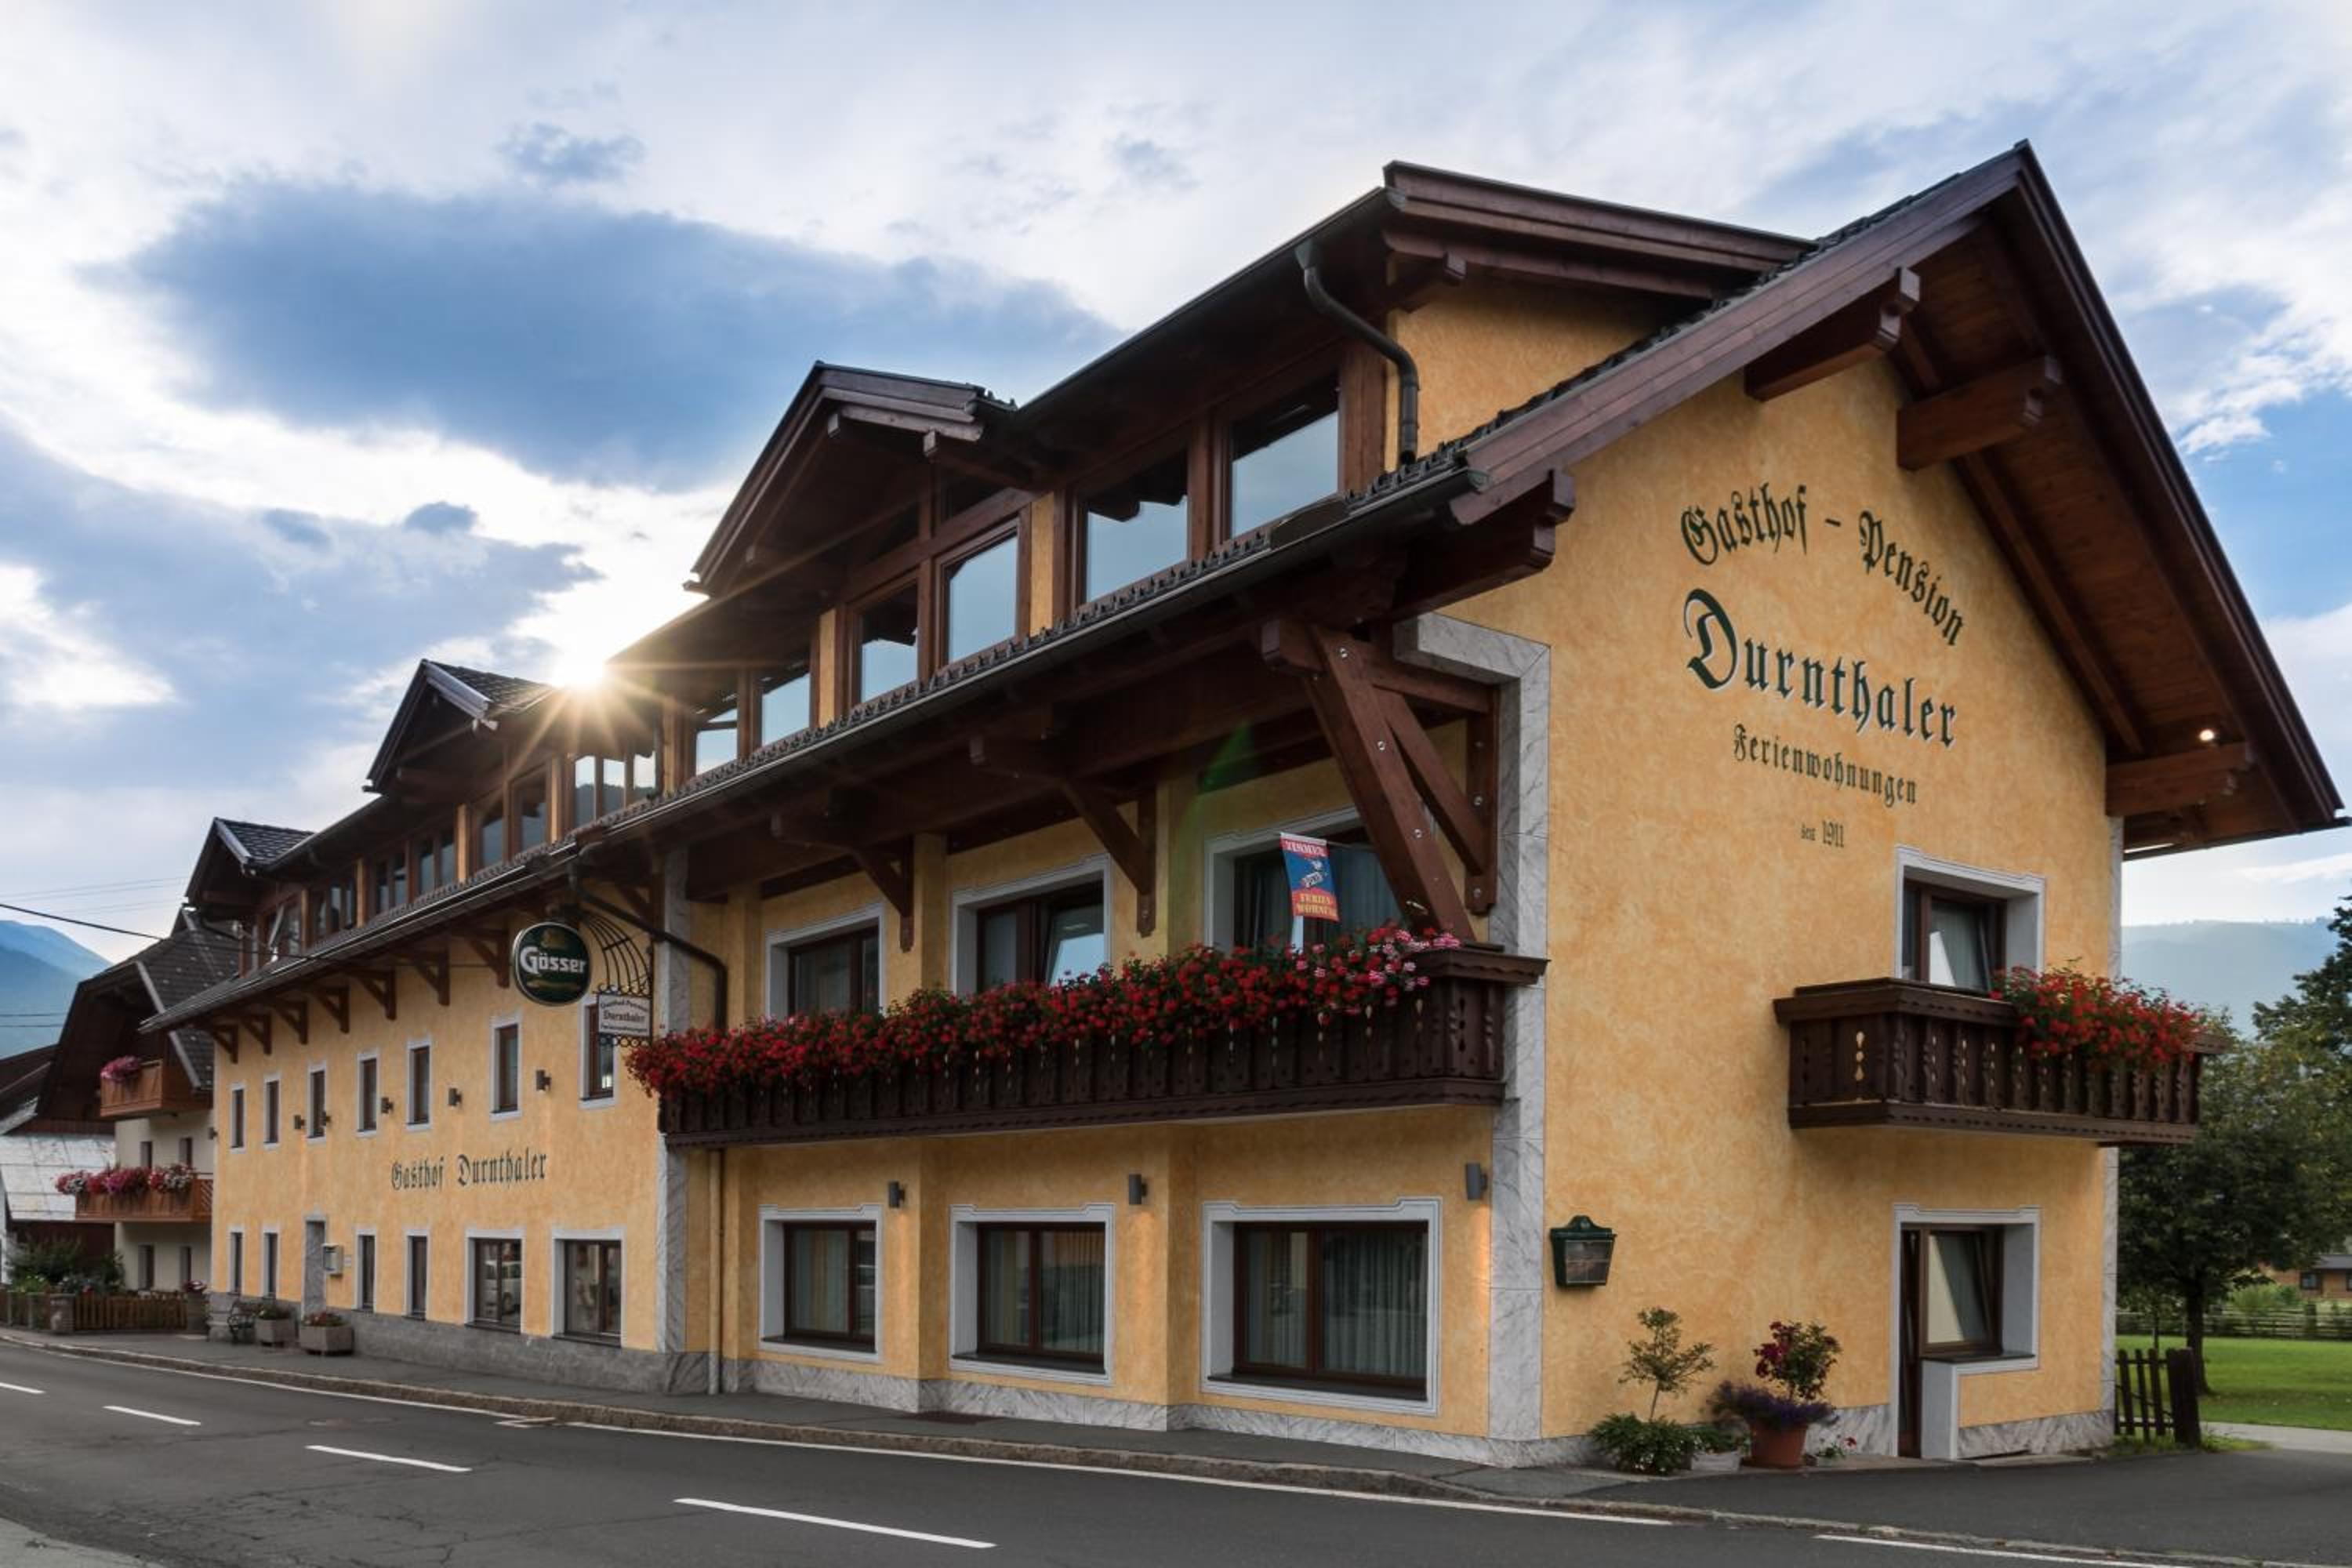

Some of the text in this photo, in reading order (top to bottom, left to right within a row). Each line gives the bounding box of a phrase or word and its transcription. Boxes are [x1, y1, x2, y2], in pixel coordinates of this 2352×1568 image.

[1680, 482, 1807, 566] Gasthof
[1858, 510, 1963, 646] Pension
[1683, 588, 1957, 749] Durnthaler
[1733, 724, 1918, 808] Ferienwohnungen
[1822, 820, 1845, 848] 1911
[519, 946, 587, 975] Gösser
[391, 1147, 547, 1191] Gasthof Durnthaler
